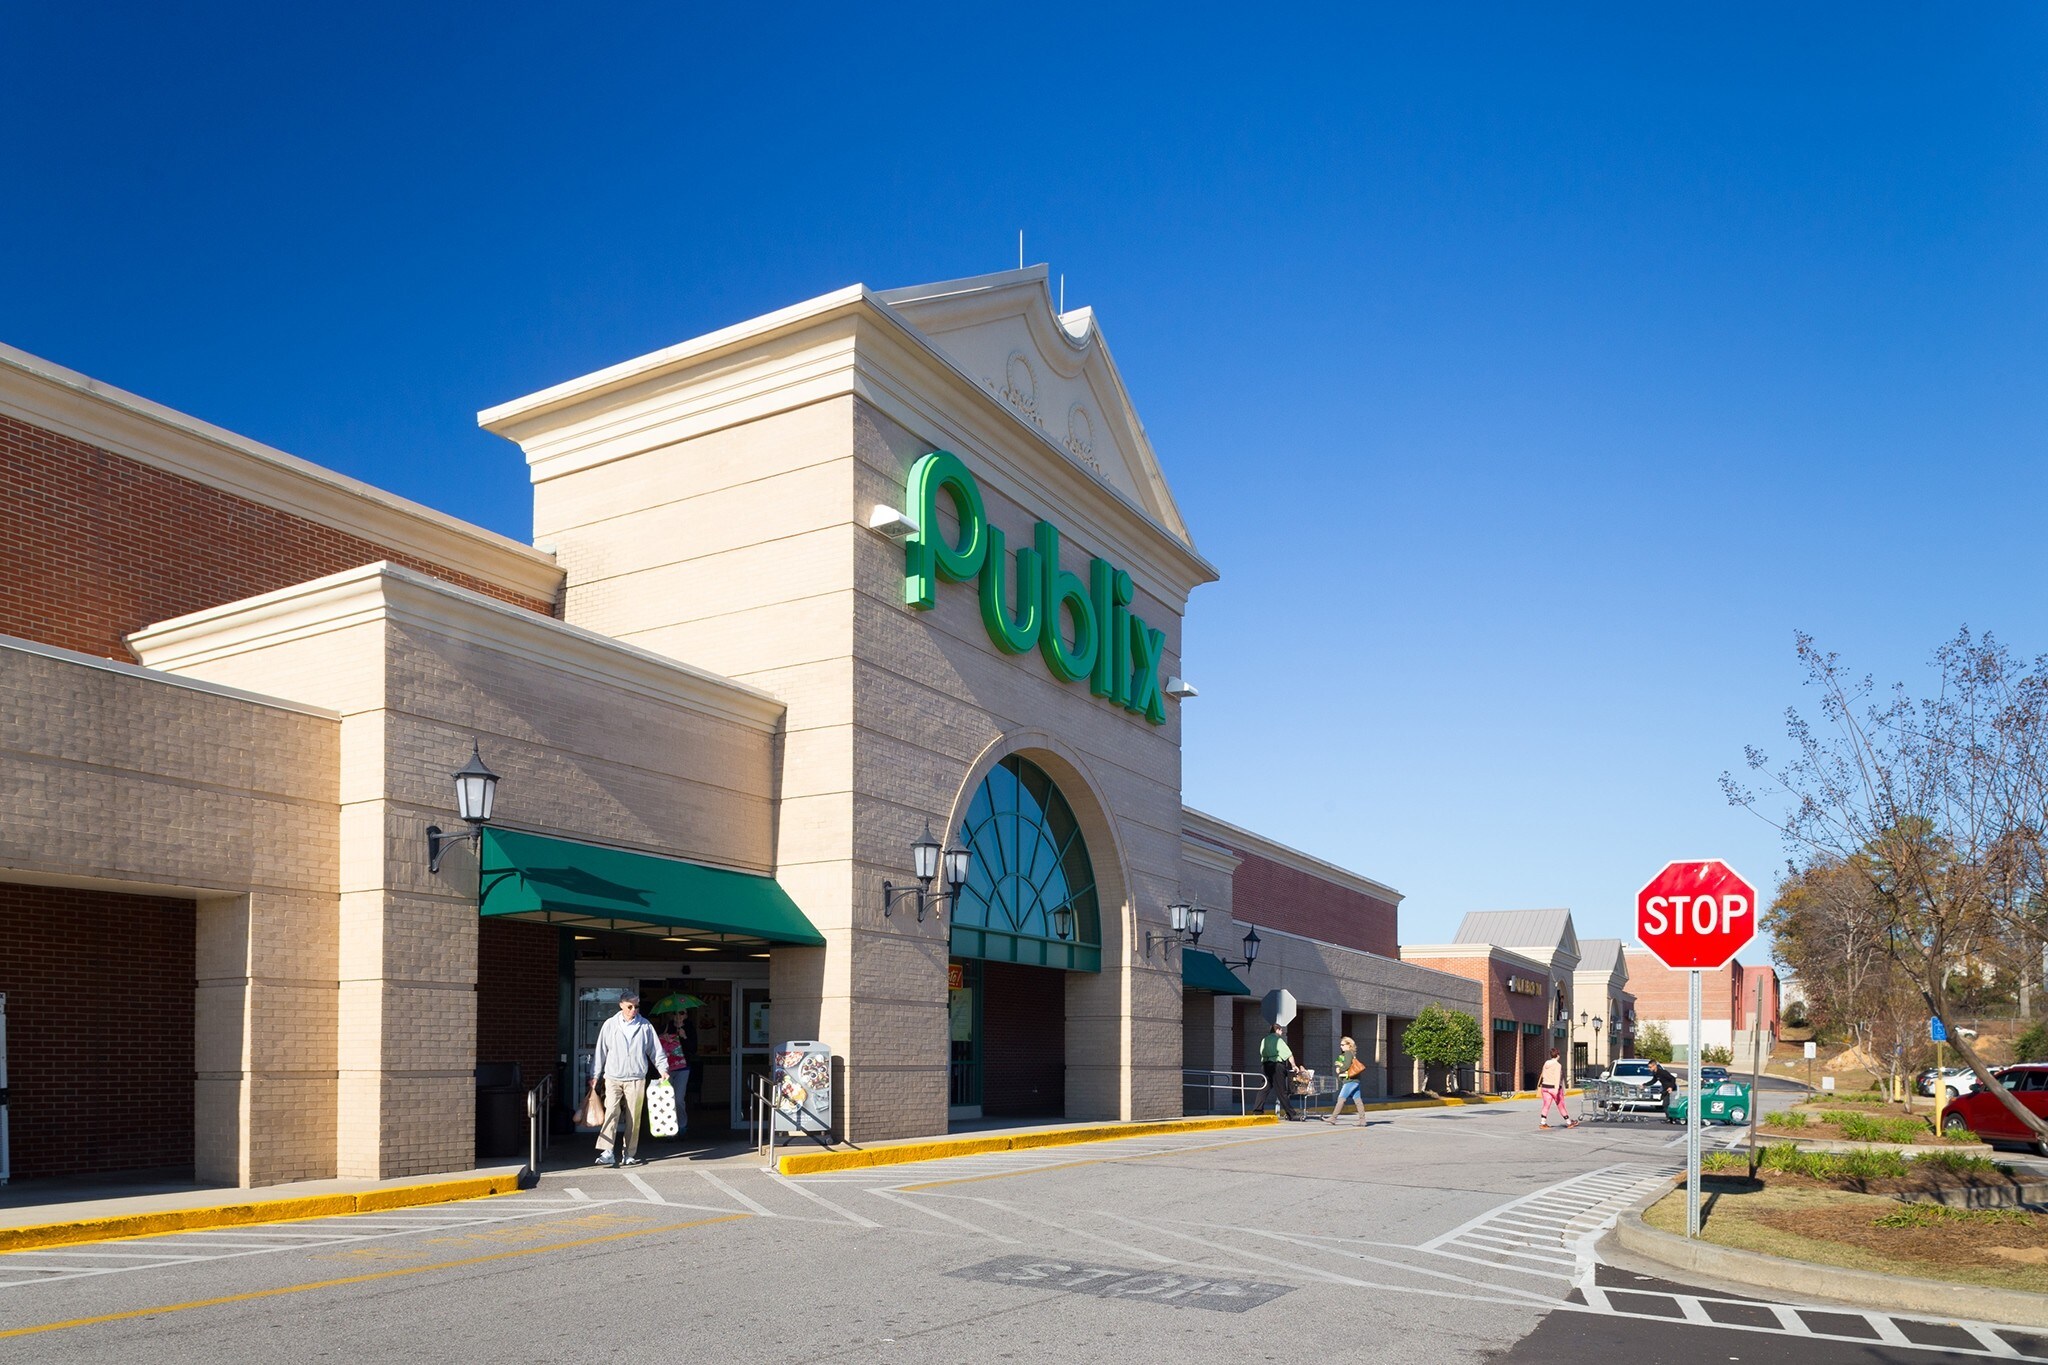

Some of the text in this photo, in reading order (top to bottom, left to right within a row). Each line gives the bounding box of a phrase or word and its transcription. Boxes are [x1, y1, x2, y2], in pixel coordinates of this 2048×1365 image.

[906, 450, 1166, 726] Publix
[1644, 894, 1748, 935] STOP
[1711, 1102, 1723, 1112] 32
